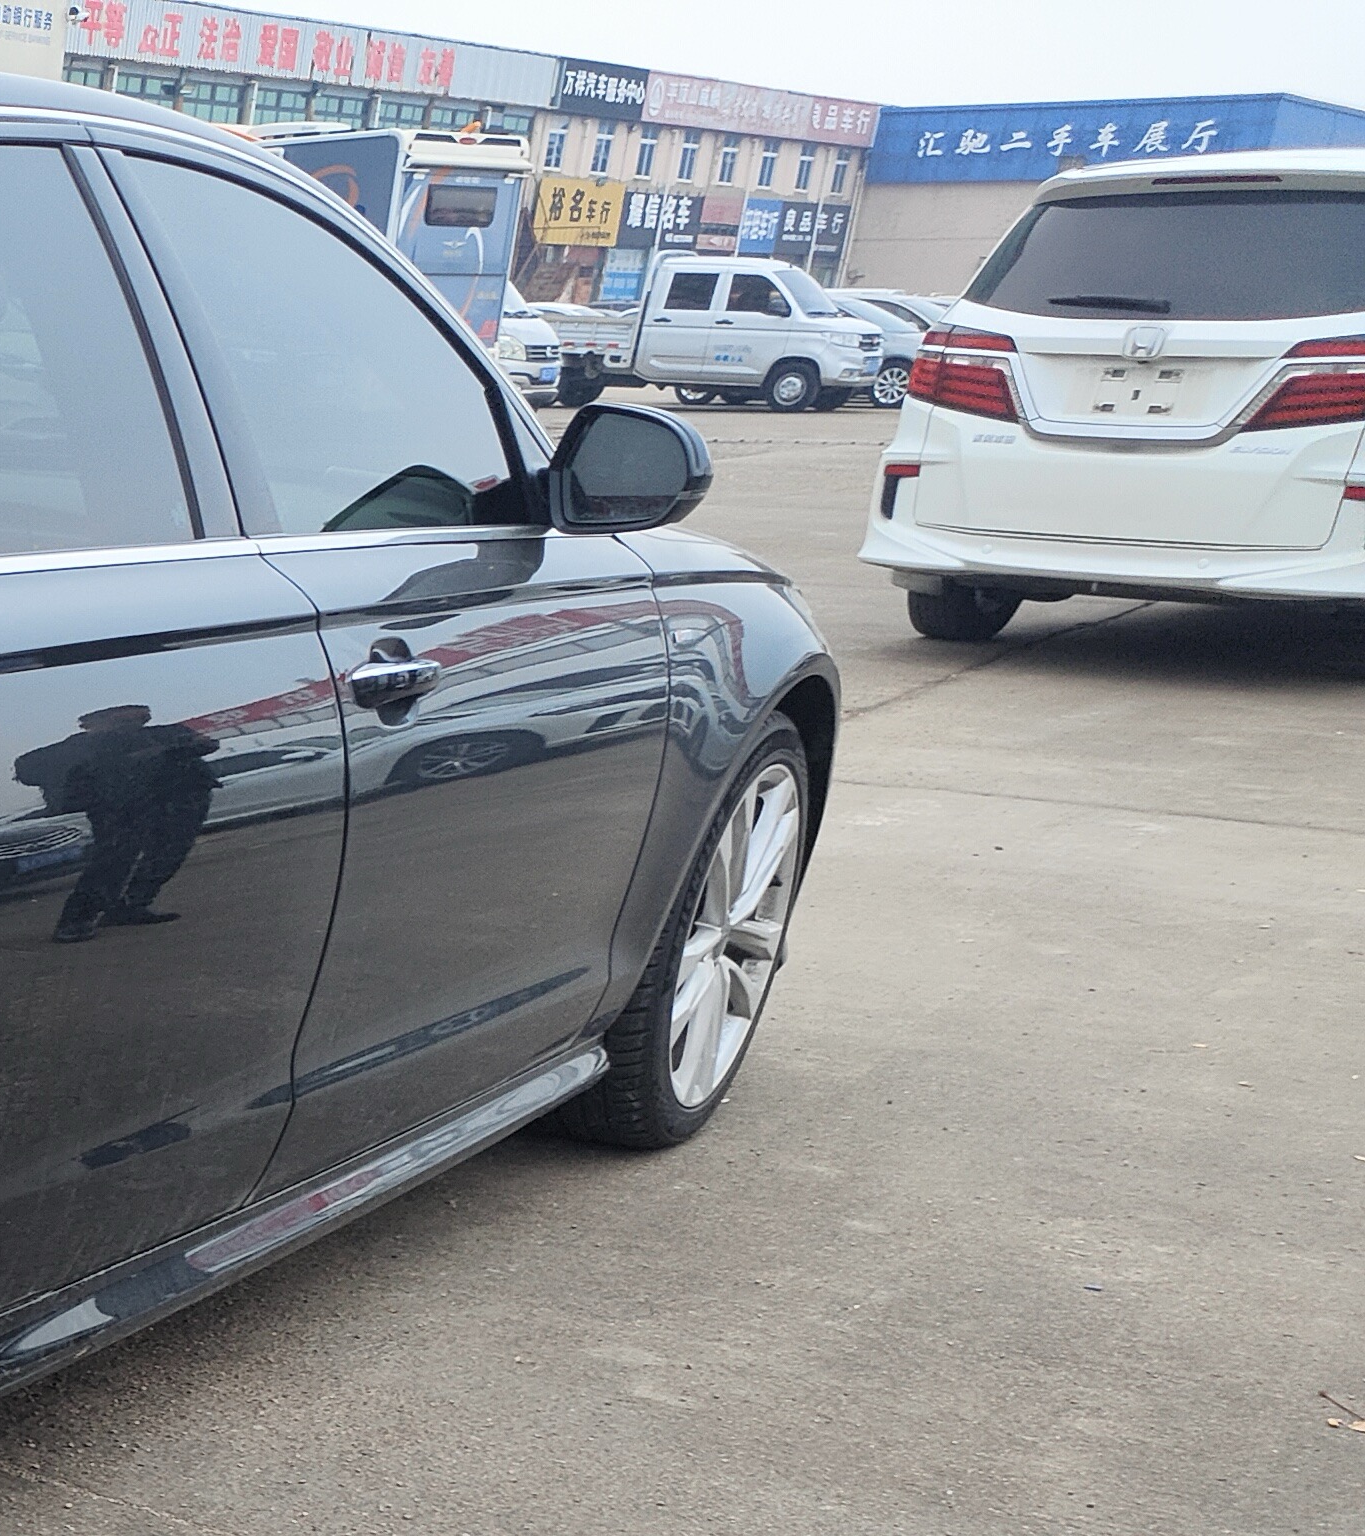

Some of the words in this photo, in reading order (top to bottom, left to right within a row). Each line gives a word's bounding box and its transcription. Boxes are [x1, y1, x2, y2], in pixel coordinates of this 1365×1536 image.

[80, 0, 128, 48] 平等
[197, 15, 241, 62] 法治
[313, 30, 354, 77] 敬业
[365, 38, 406, 83] 诚信
[418, 47, 455, 87] 友善
[562, 69, 646, 105] 万祥汽车服务中心
[811, 102, 872, 136] 良品车行
[916, 118, 1220, 159] 汇驰二手车展厅
[548, 186, 612, 225] 裕名车行
[783, 207, 845, 235] 良品车行
